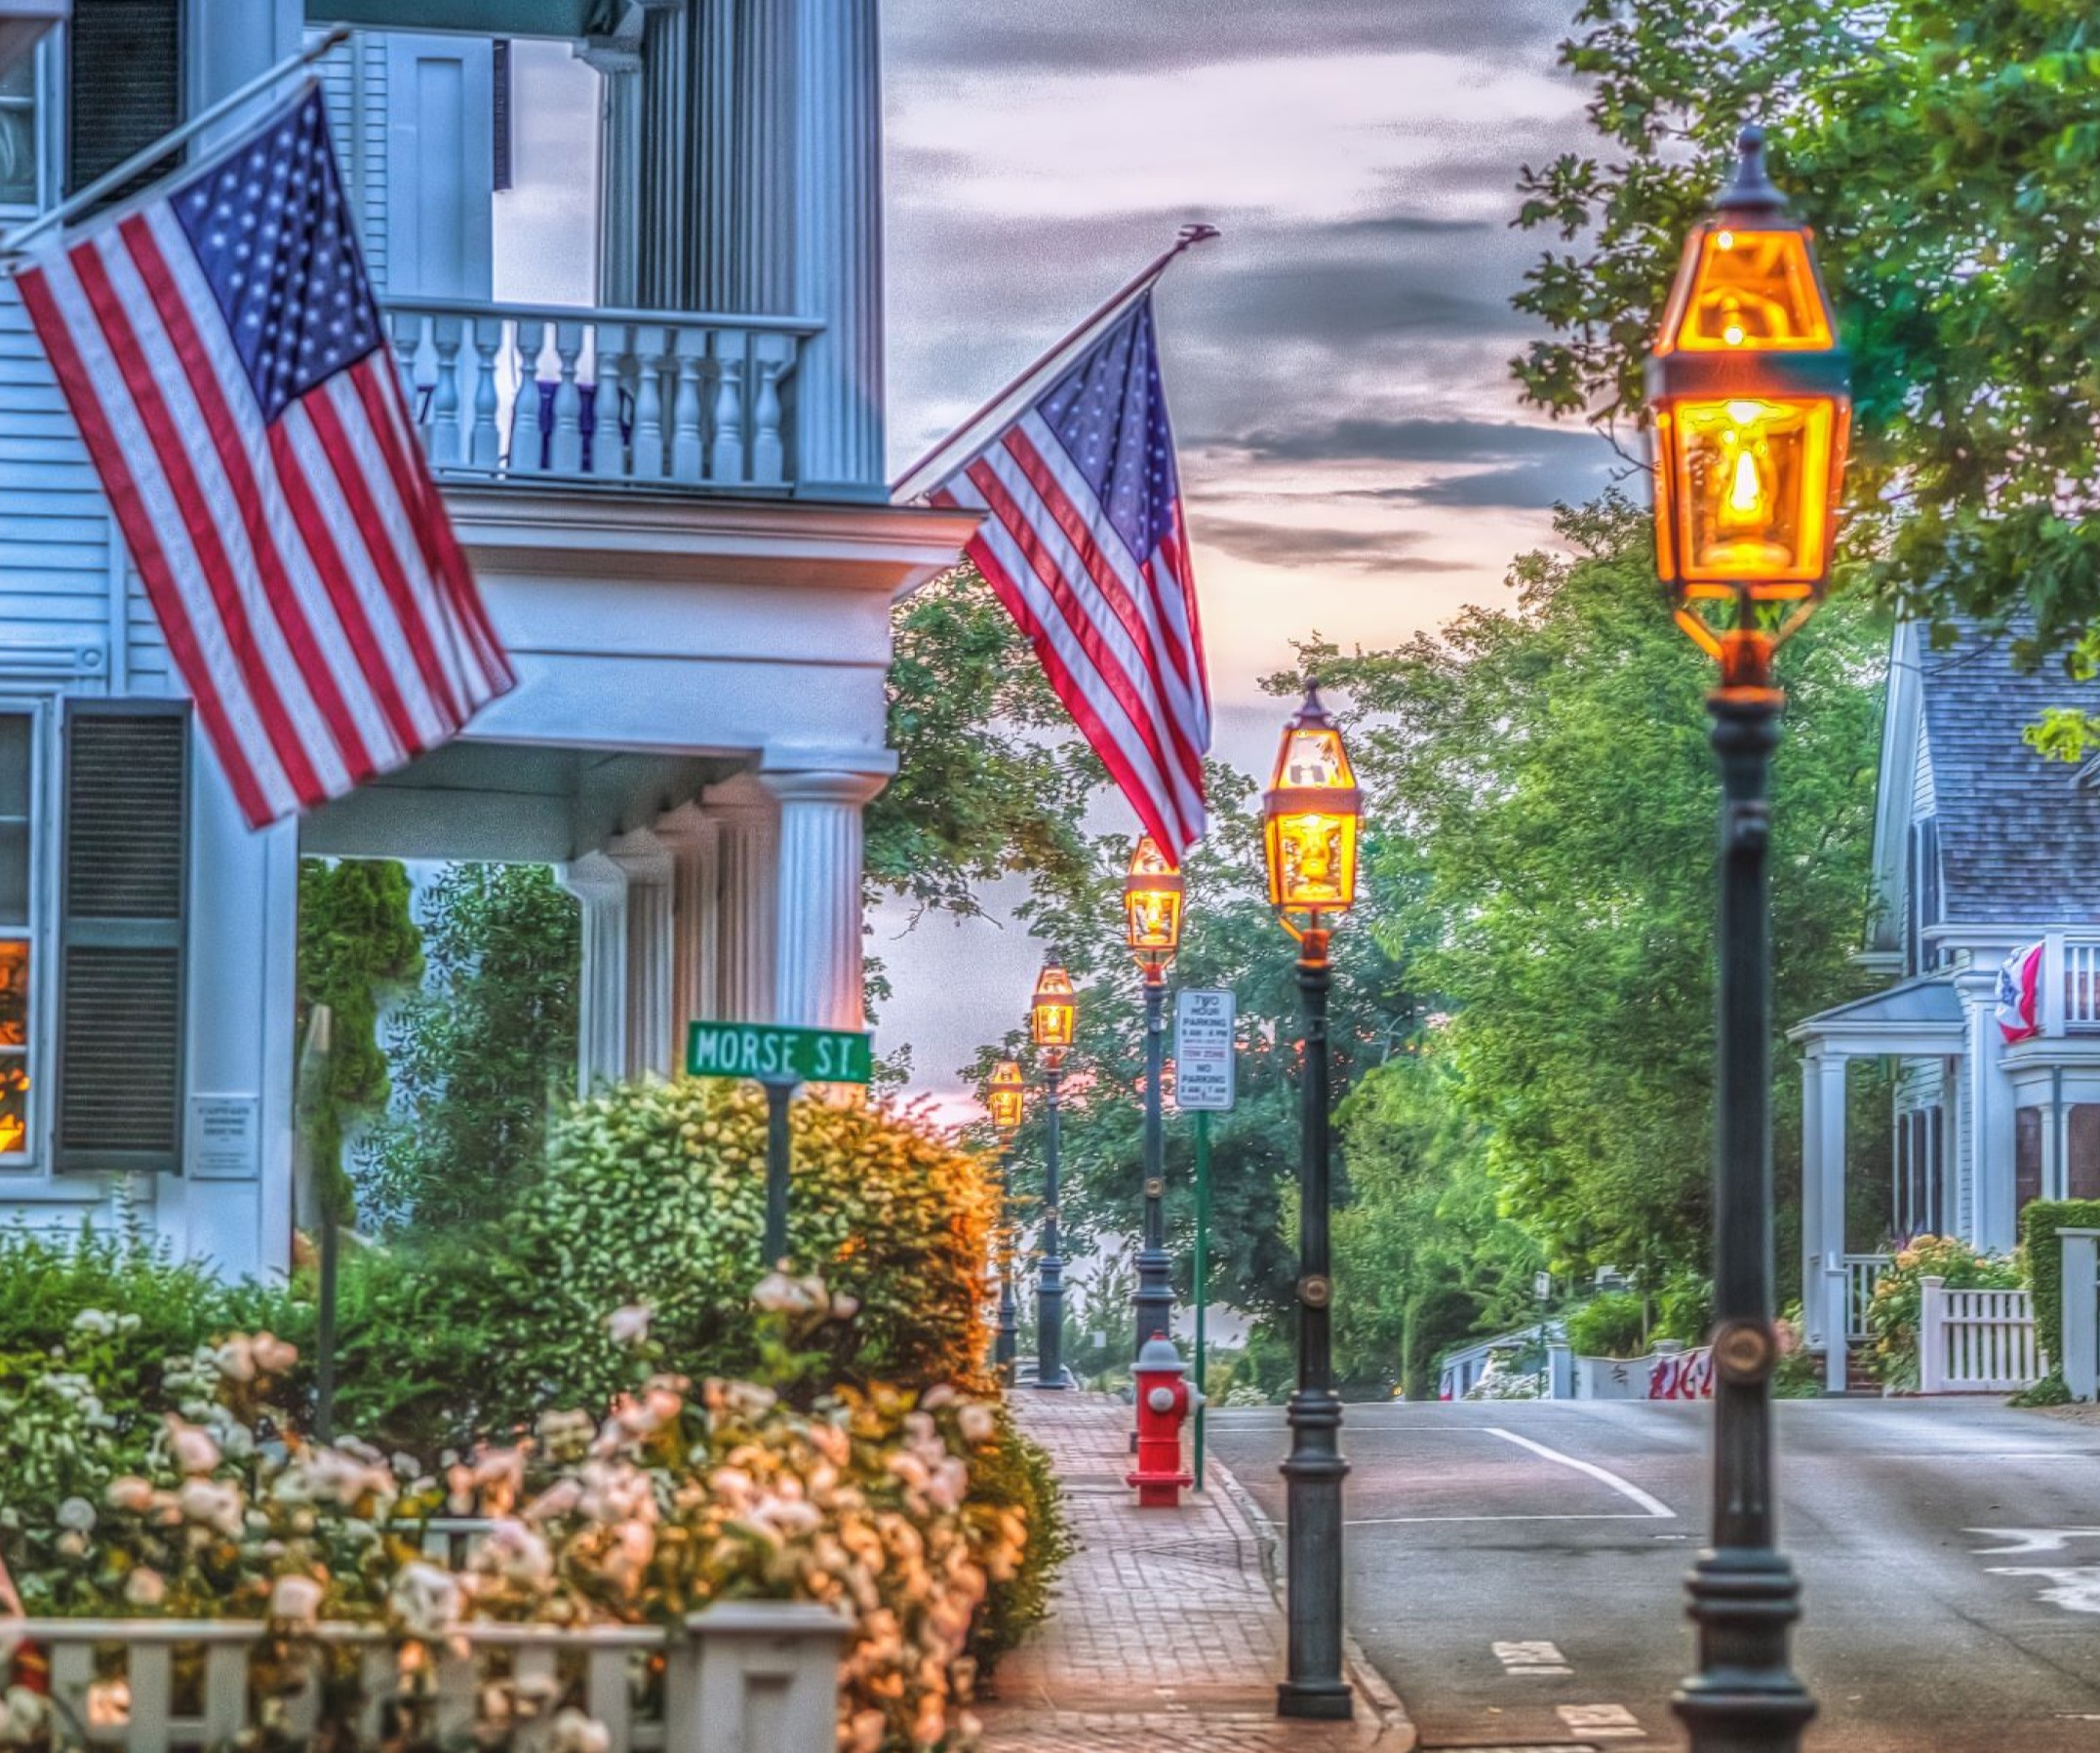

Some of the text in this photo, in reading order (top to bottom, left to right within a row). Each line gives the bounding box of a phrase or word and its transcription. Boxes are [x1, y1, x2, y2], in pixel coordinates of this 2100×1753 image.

[1195, 995, 1219, 1007] TWO
[1182, 1017, 1226, 1027] PARKING
[696, 1029, 799, 1074] MORSE
[1181, 1075, 1226, 1084] PARKING
